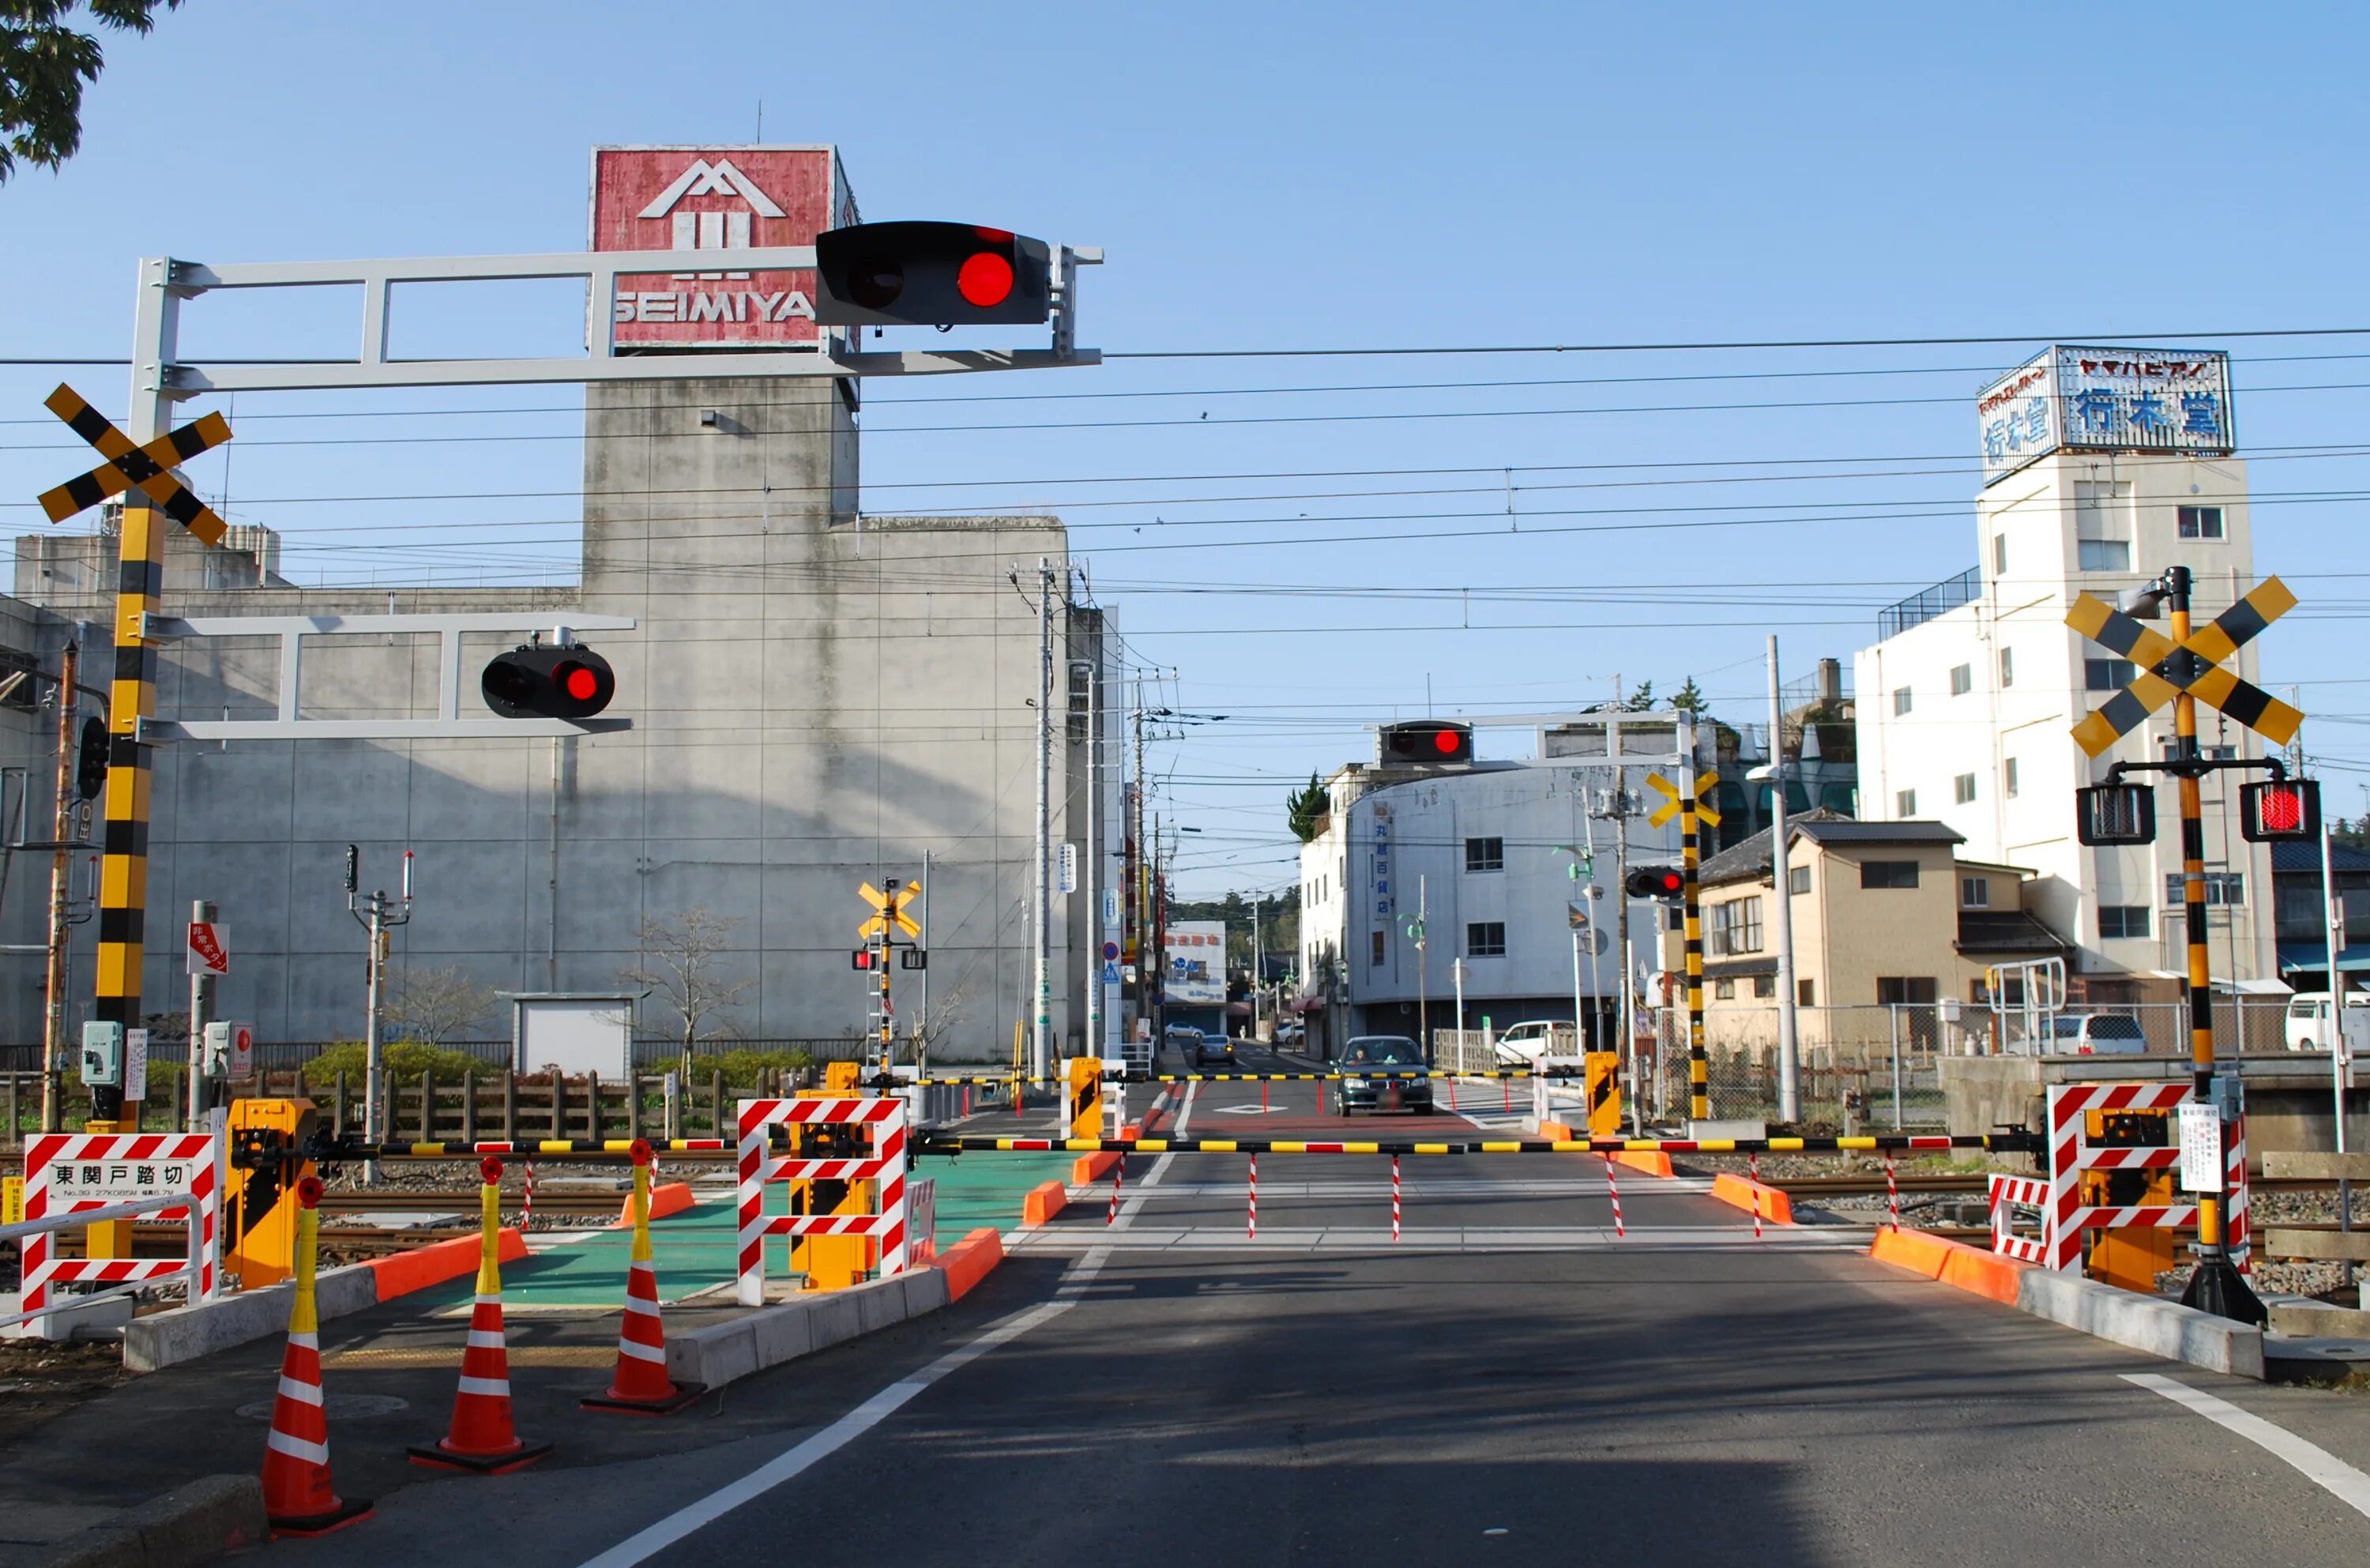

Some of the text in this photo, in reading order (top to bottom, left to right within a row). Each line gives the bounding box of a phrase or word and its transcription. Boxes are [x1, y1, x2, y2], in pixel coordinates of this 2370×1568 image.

[615, 291, 816, 322] SEIMIYA
[2080, 359, 2205, 377] ヤマハピアノ
[2074, 388, 2218, 434] 行木堂
[193, 926, 226, 970] 非常ボタン
[55, 1165, 182, 1185] 東関戸踏切
